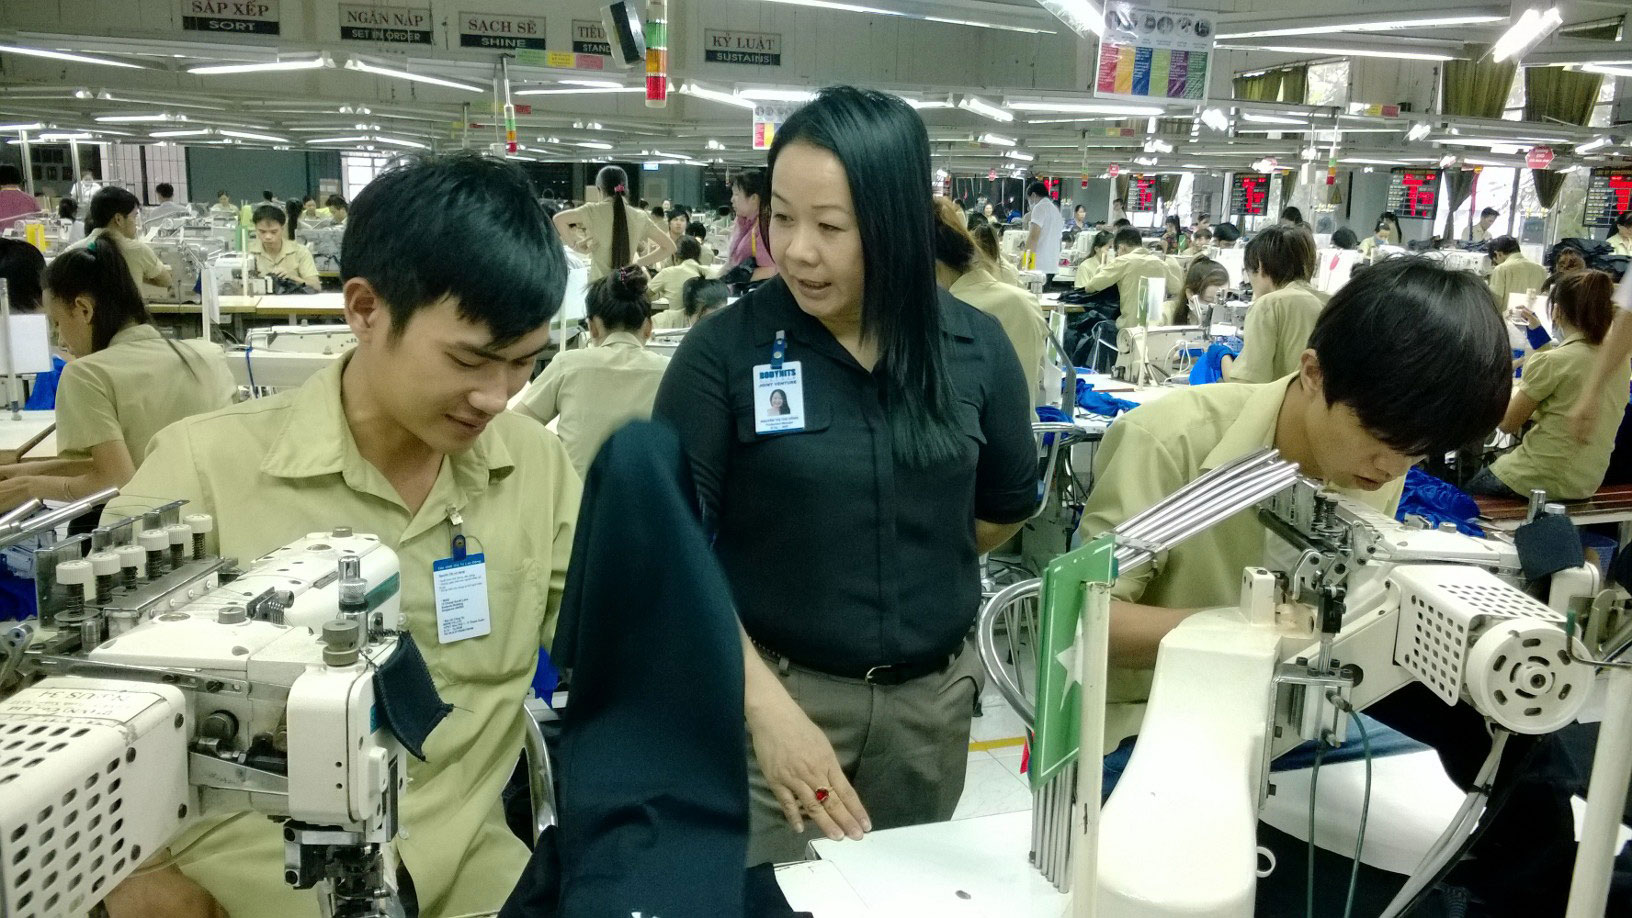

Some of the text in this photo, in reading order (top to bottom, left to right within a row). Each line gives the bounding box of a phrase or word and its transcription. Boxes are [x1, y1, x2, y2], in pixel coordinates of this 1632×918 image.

[209, 20, 256, 31] SORT
[468, 18, 512, 34] SẠCH
[351, 29, 421, 41] SET IN ORDER
[481, 37, 527, 48] SHINE
[716, 52, 770, 63] SUSTAINS
